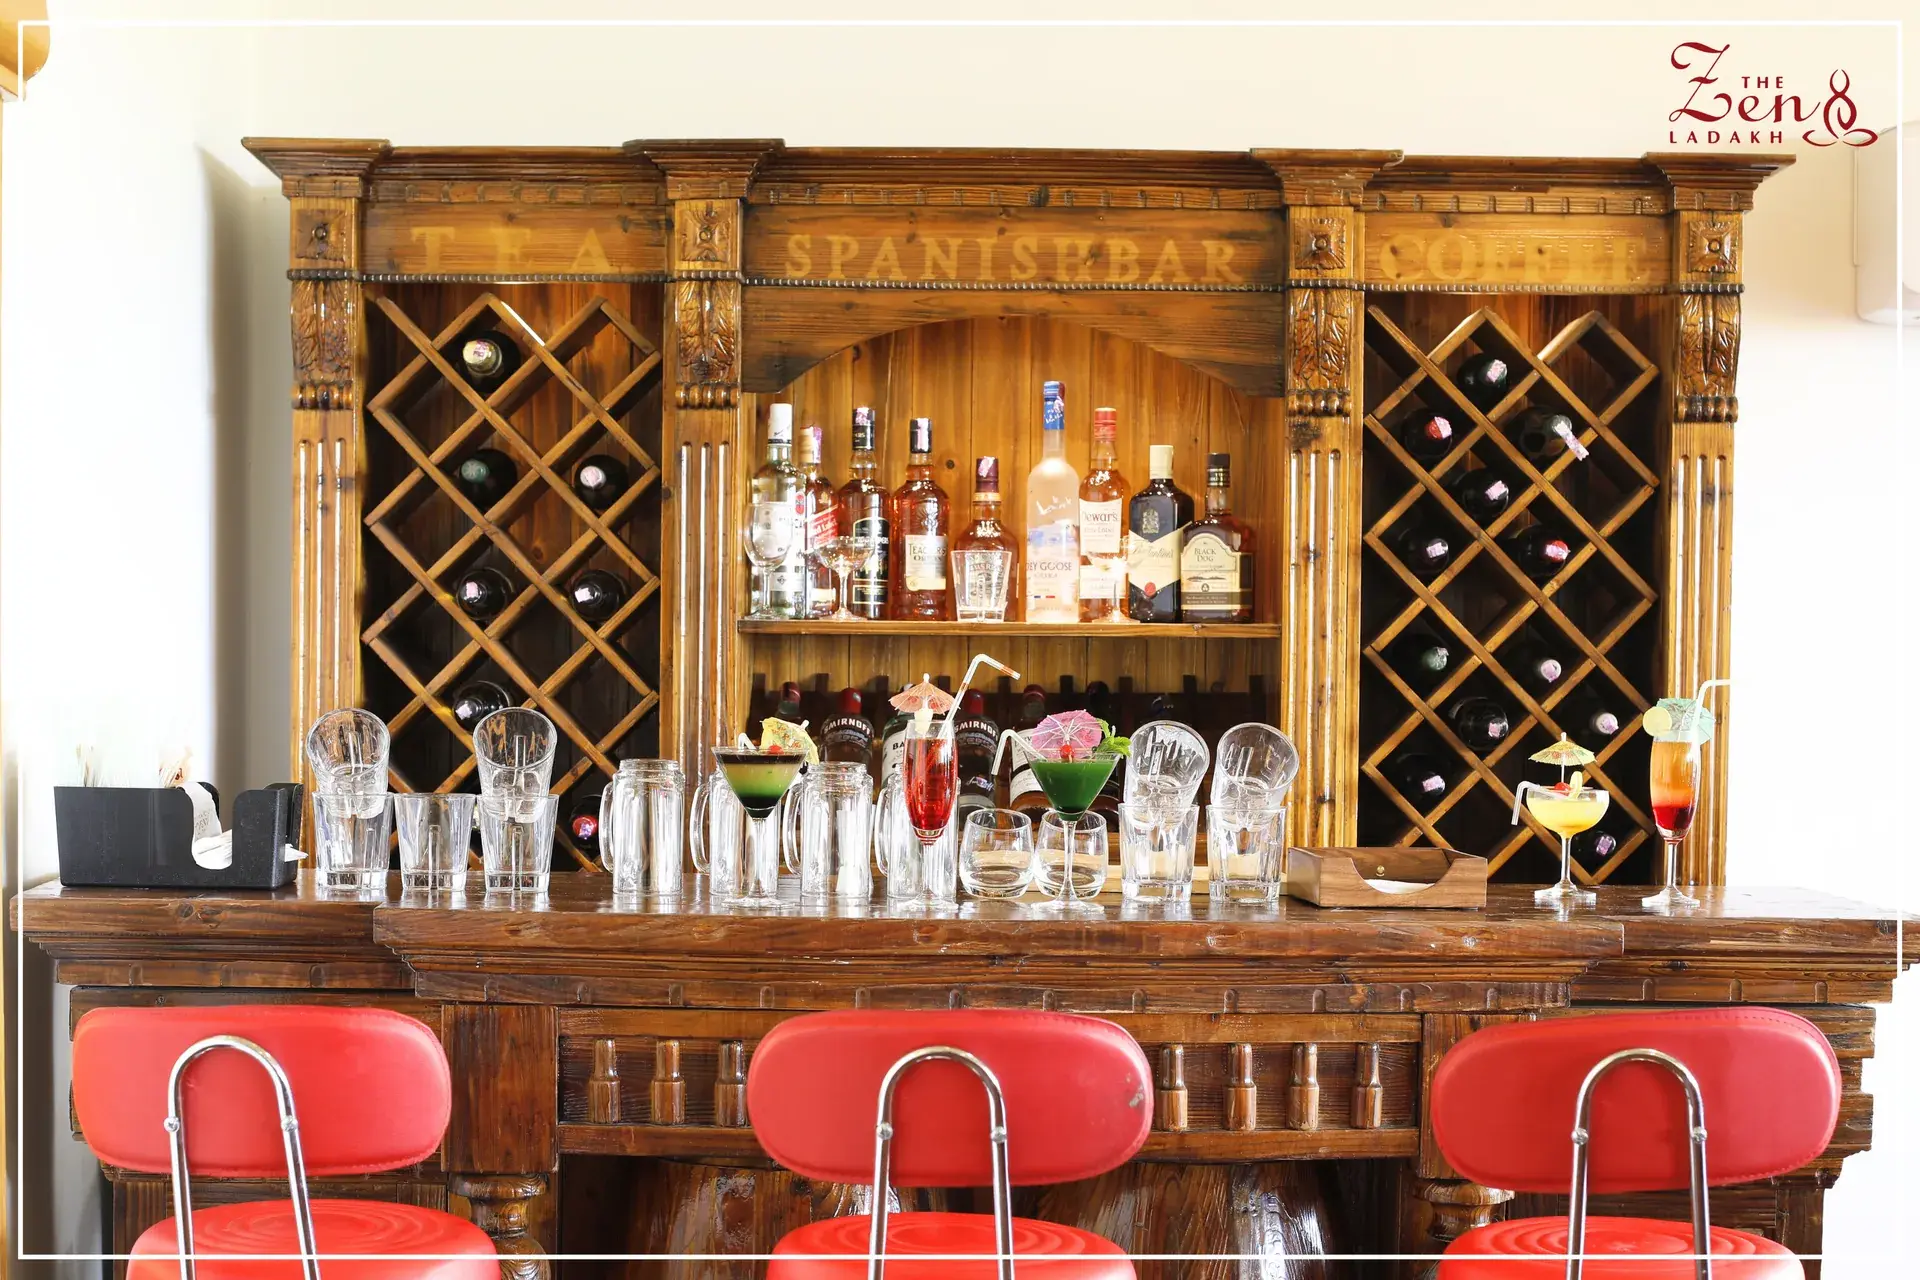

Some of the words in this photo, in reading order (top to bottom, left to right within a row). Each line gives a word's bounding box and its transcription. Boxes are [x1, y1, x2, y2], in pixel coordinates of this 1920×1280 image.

[1194, 547, 1217, 556] BLACK
[1196, 555, 1214, 563] DOG
[1039, 561, 1073, 572] GOOSE
[954, 720, 999, 742] SMIRNOF
